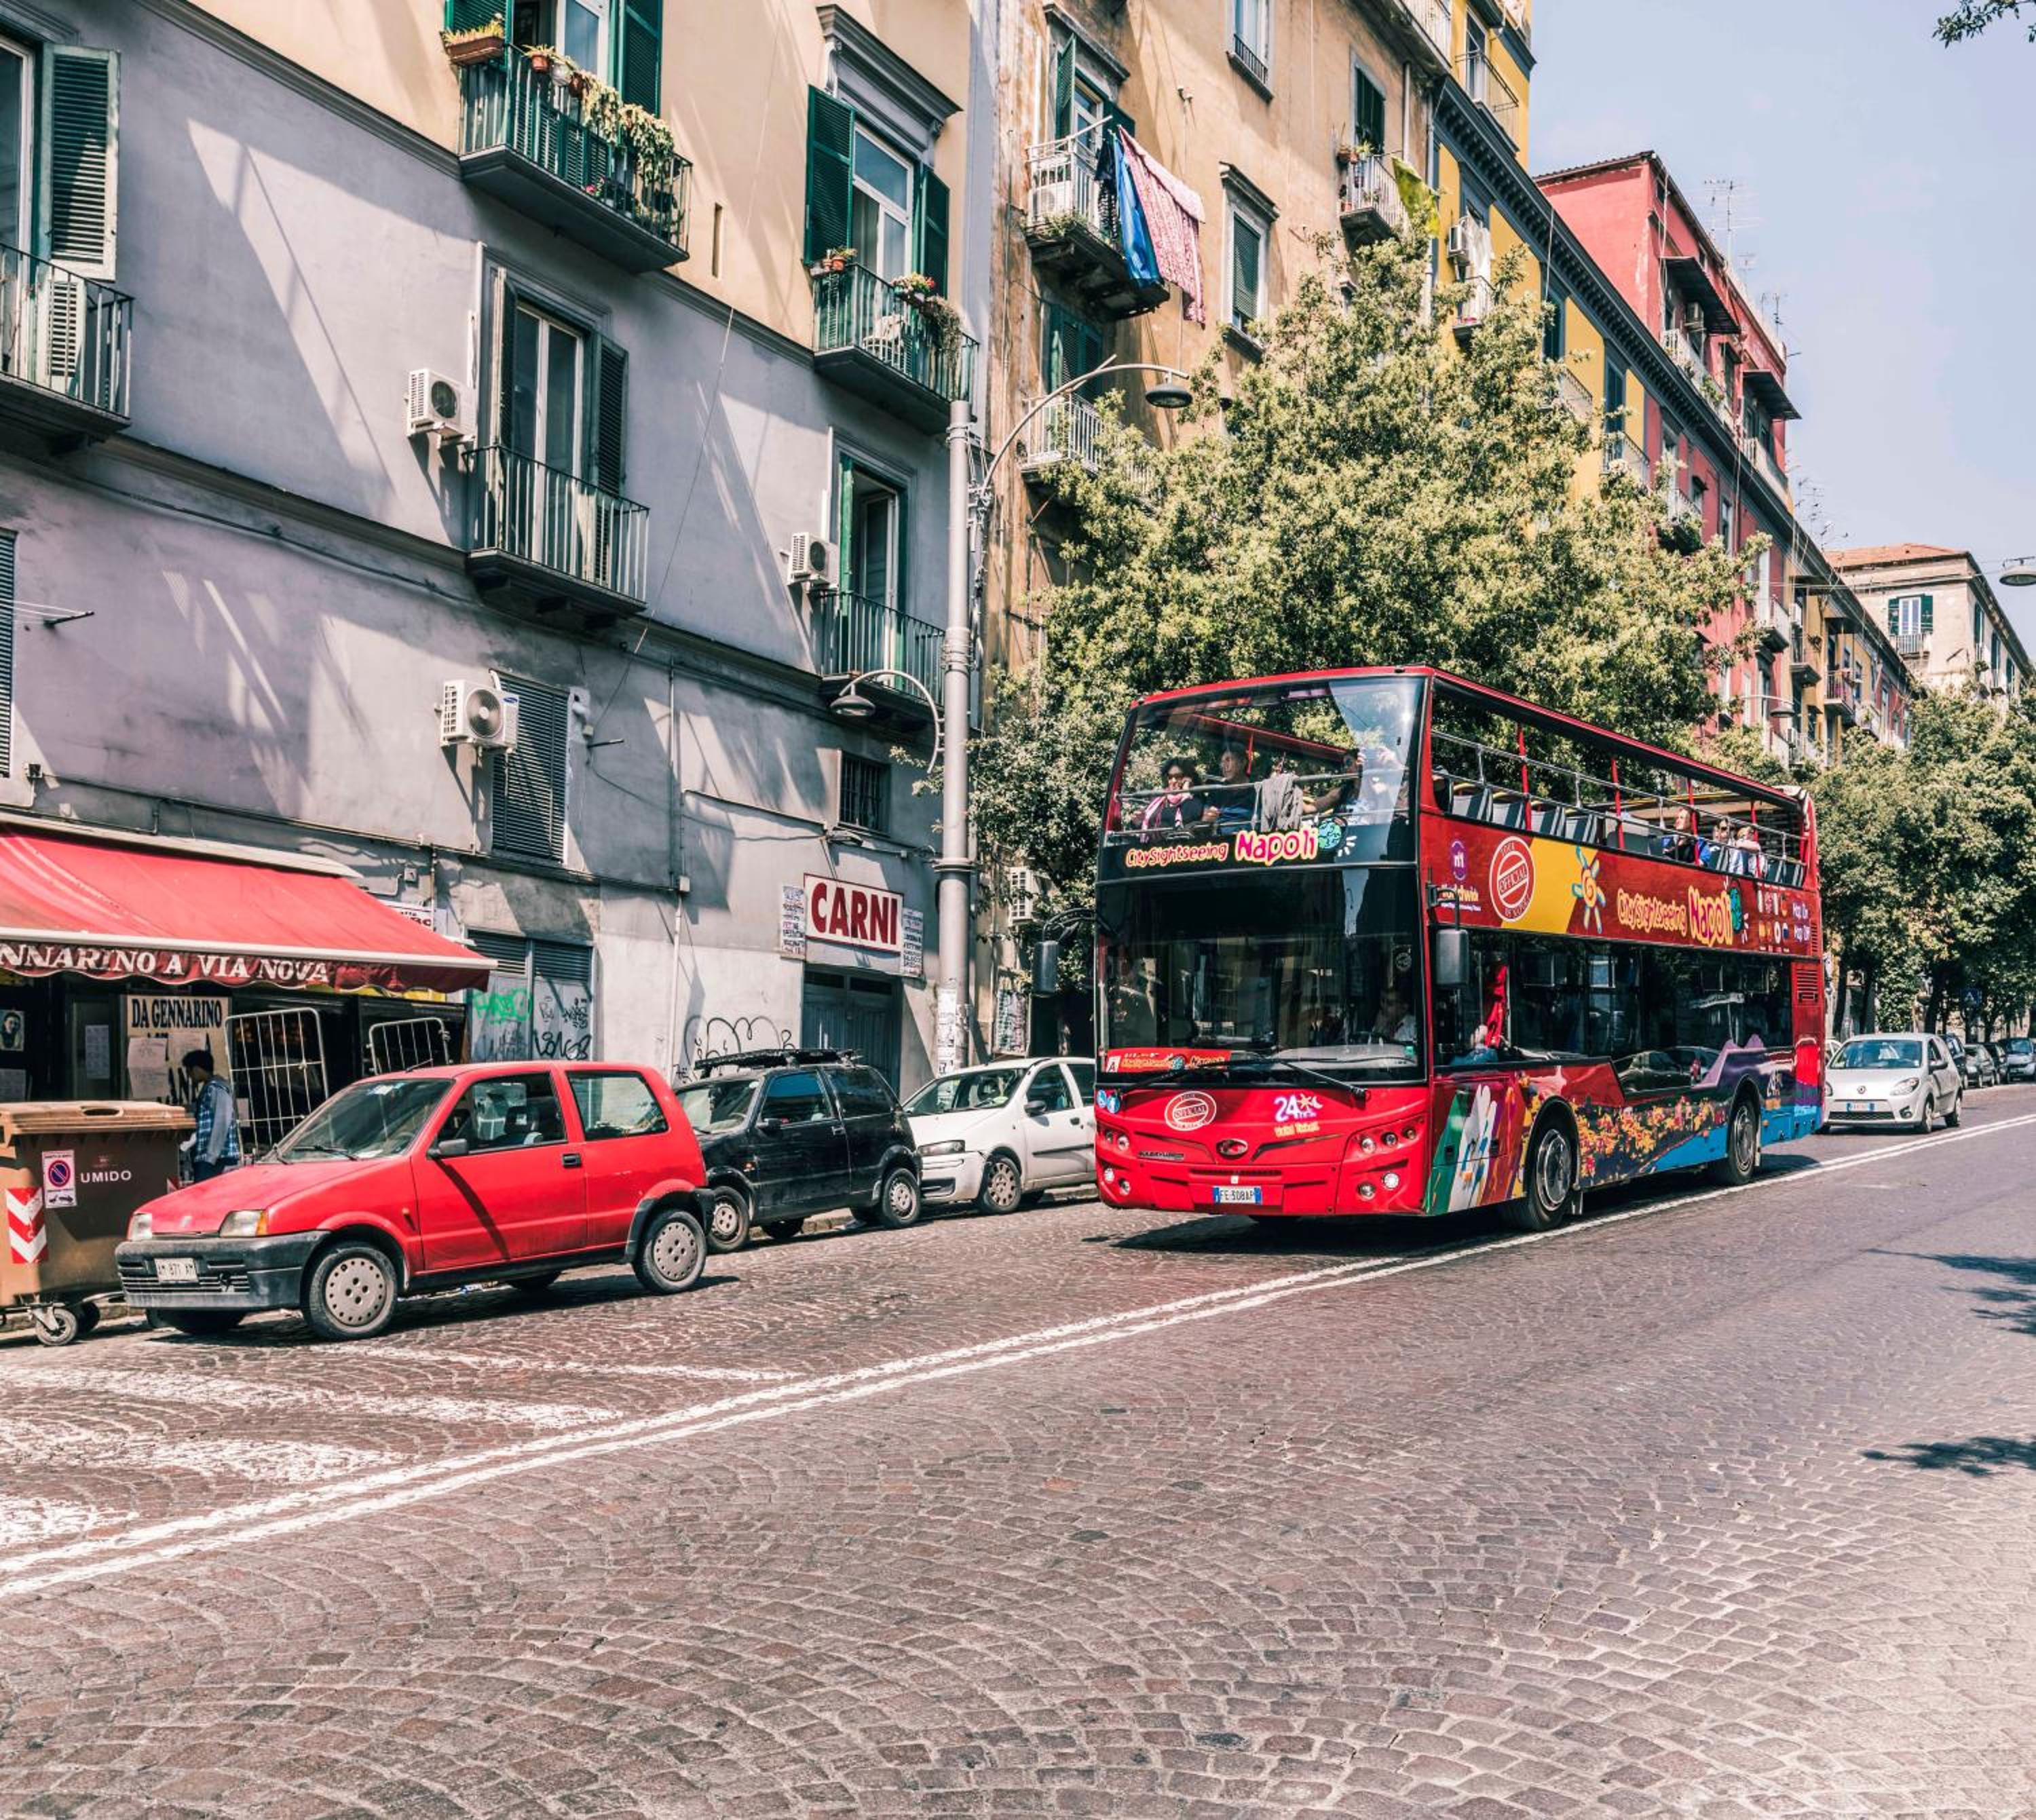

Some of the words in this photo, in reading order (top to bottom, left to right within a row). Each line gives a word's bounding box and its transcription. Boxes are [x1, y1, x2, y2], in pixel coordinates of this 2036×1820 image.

[1235, 827, 1319, 866] Napoli
[811, 882, 898, 945] CARNI
[1689, 885, 1733, 947] Napoli
[163, 955, 185, 975] A
[197, 954, 250, 979] VIA
[257, 958, 329, 983] NOVA
[132, 999, 149, 1028] DA
[151, 999, 223, 1029] GENNARINO
[1274, 1095, 1299, 1122] 24
[80, 1170, 132, 1183] UMIDO
